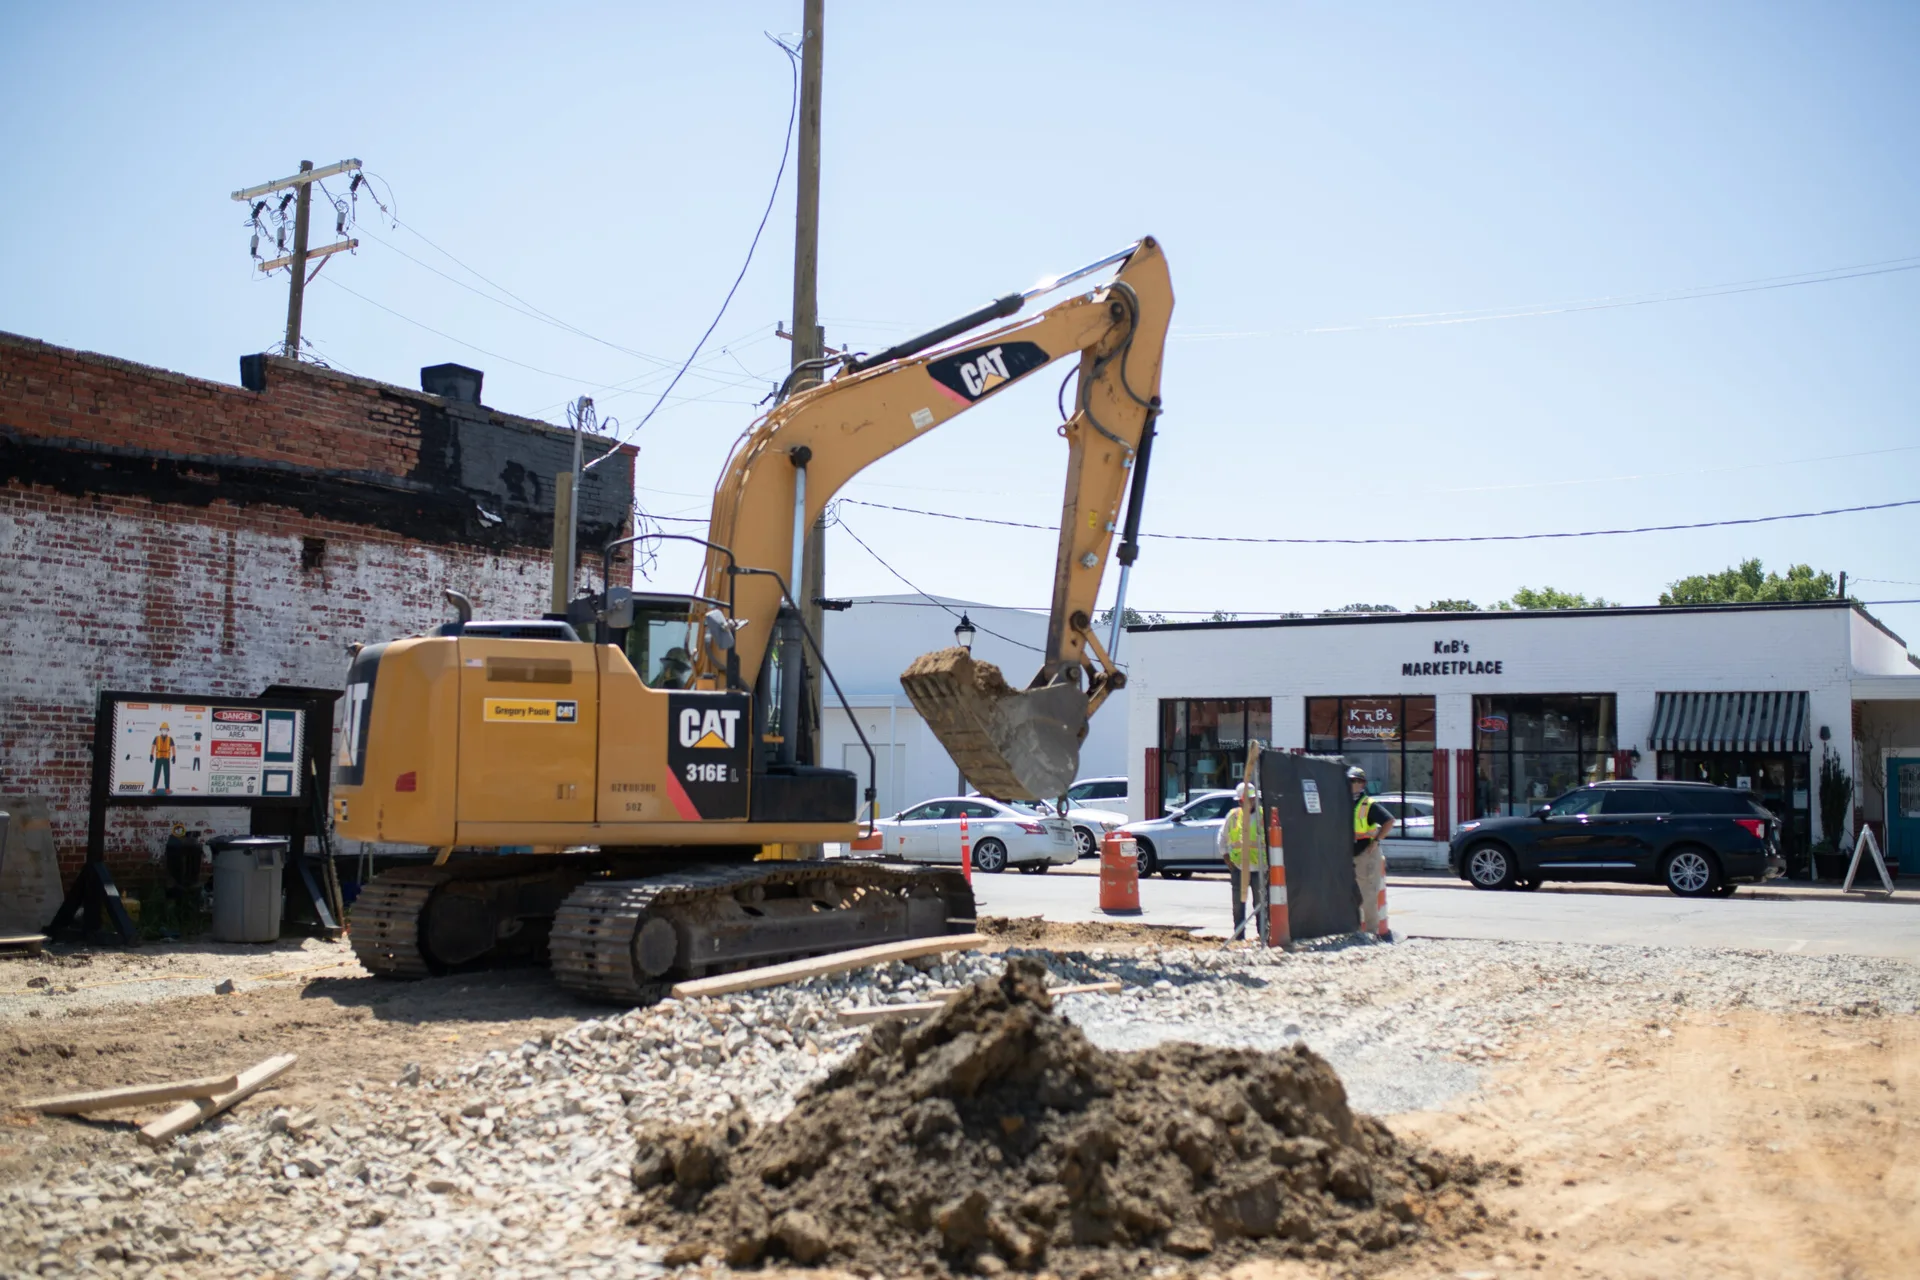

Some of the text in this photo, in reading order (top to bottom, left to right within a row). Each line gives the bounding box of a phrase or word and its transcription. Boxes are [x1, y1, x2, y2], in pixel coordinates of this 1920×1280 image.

[960, 346, 1011, 397] CAT
[1434, 640, 1469, 654] KnB's
[1402, 661, 1503, 676] MARKETPLACE
[222, 712, 252, 720] DANGER
[495, 706, 551, 717] Gregory Poole
[556, 706, 575, 718] CAT
[679, 708, 741, 749] CAT
[1347, 724, 1396, 738] Marketplace
[686, 763, 740, 782] 316E L
